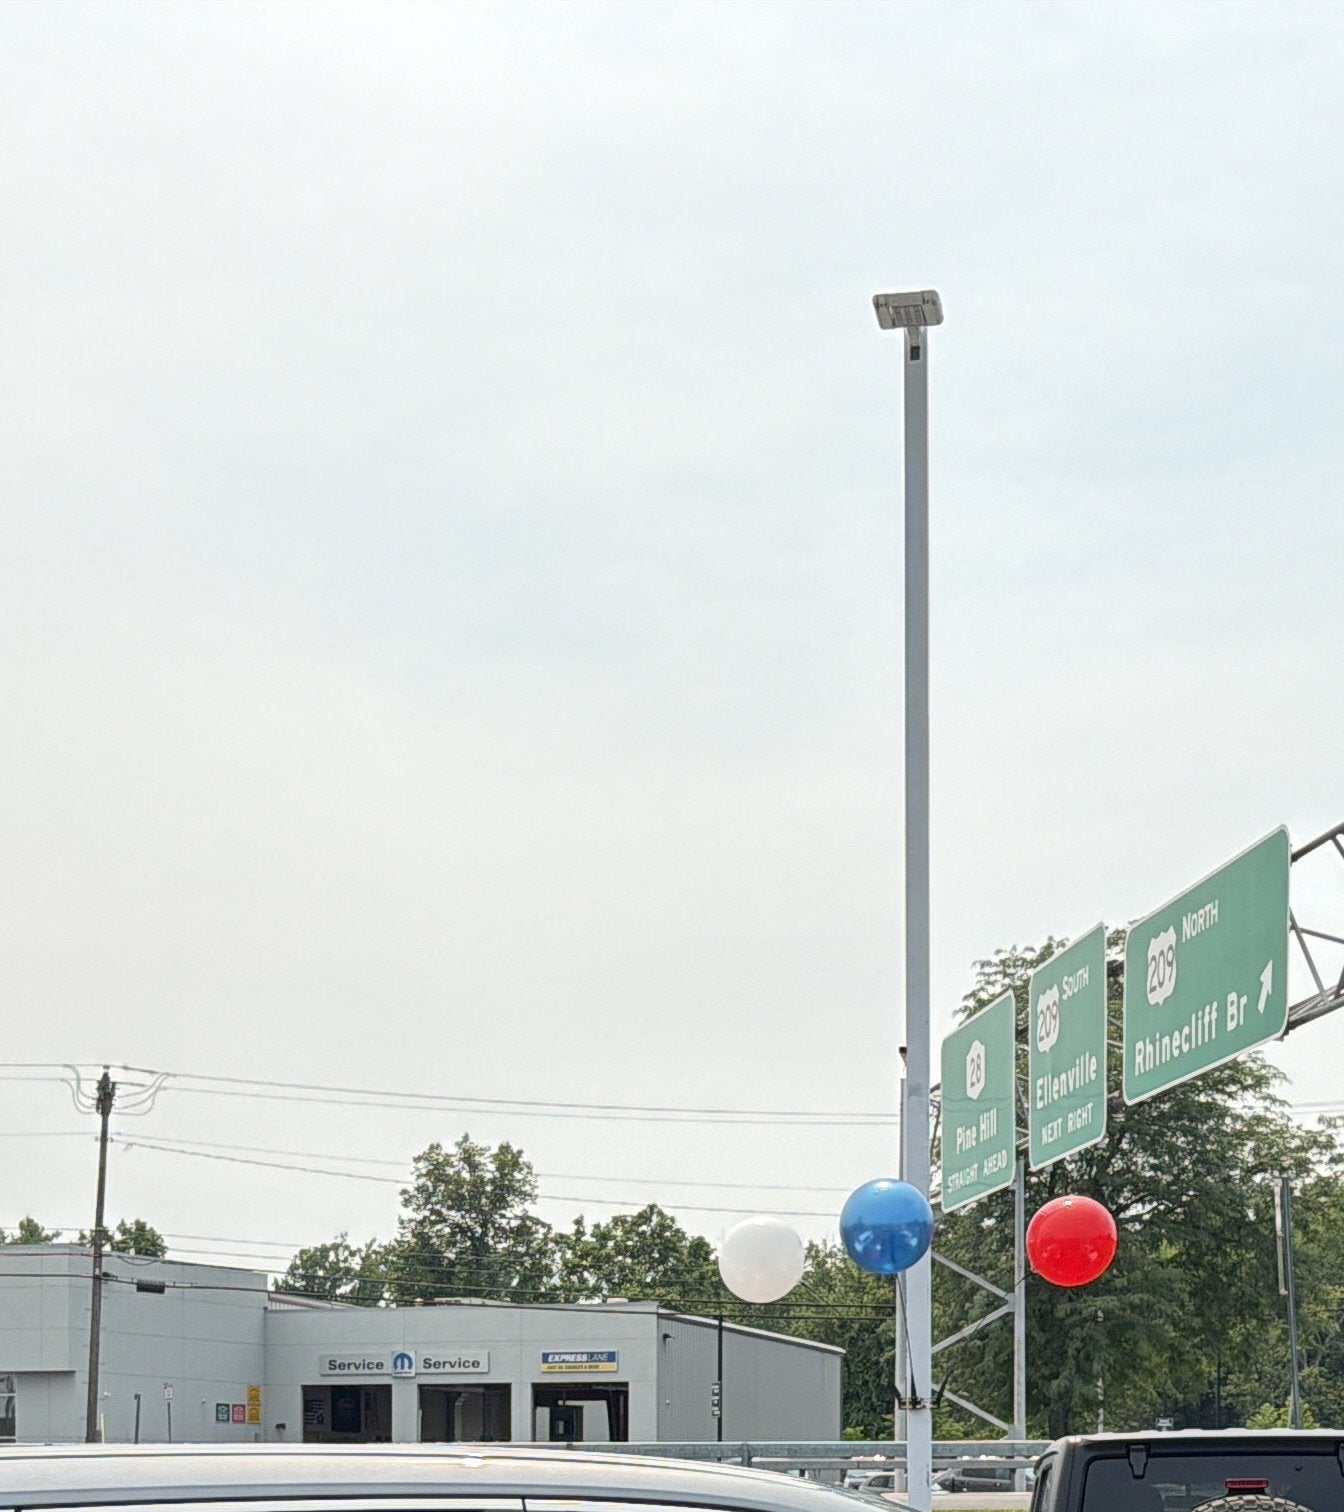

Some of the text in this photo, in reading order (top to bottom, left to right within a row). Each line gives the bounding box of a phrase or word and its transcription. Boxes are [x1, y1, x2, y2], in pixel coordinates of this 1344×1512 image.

[1182, 900, 1219, 943] NORTH
[1062, 965, 1090, 1001] SOUTH
[1149, 944, 1175, 994] 209
[1038, 1001, 1058, 1043] 209
[1135, 991, 1248, 1077] Rhinecliff Br
[969, 1053, 982, 1089] 28
[1036, 1052, 1097, 1110] Ellenville
[956, 1107, 997, 1155] Pine Hill
[1041, 1102, 1094, 1146] NEXT RIGHT
[328, 1357, 481, 1371] Service Service
